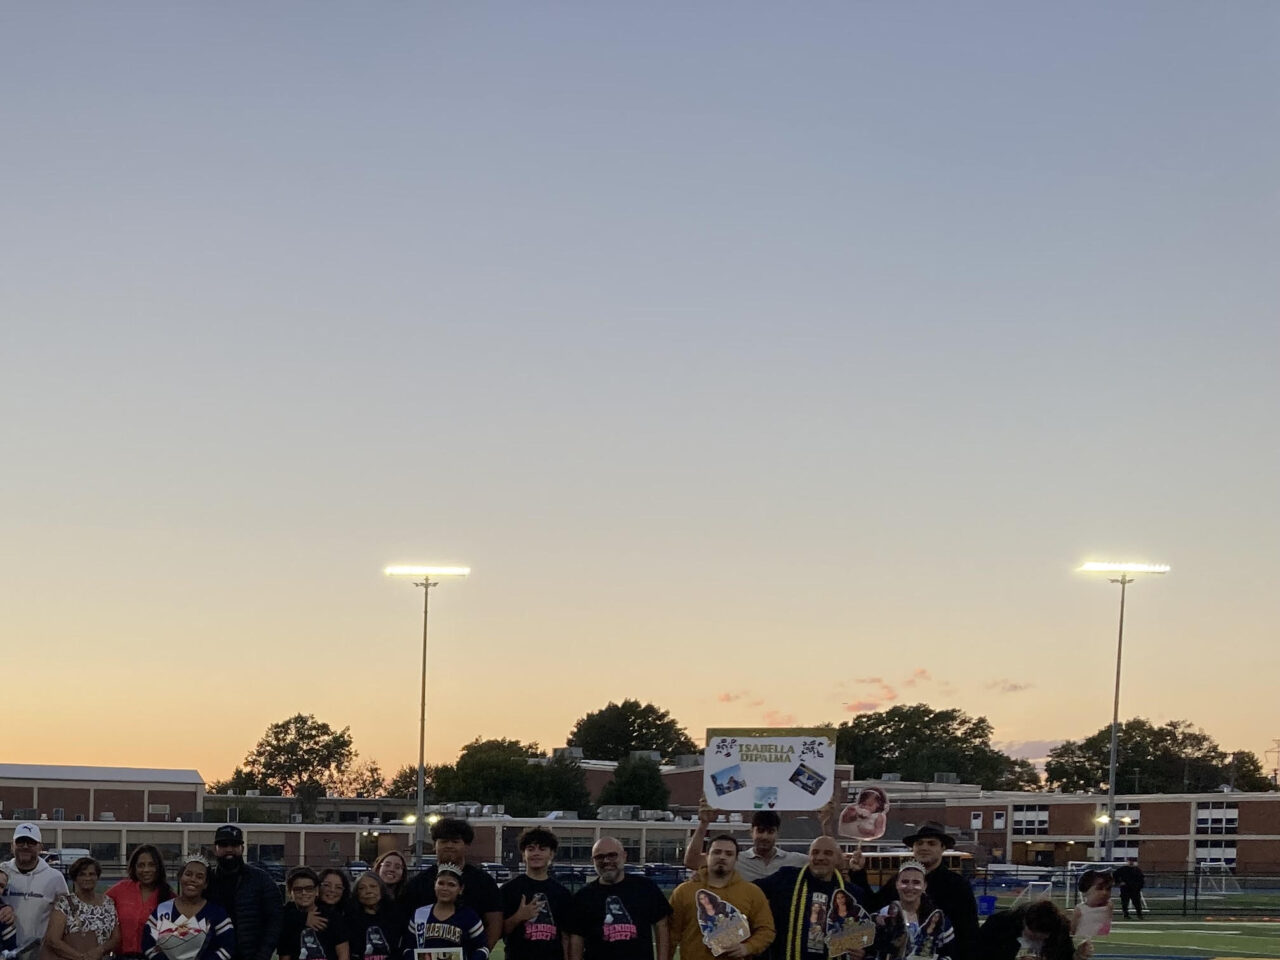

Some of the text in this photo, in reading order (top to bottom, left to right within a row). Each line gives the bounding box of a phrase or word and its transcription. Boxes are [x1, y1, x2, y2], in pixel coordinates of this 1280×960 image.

[738, 744, 795, 754] ISABELLA
[740, 753, 792, 763] DIPALMA
[525, 923, 558, 936] SENIOR
[603, 924, 637, 935] SENIOR
